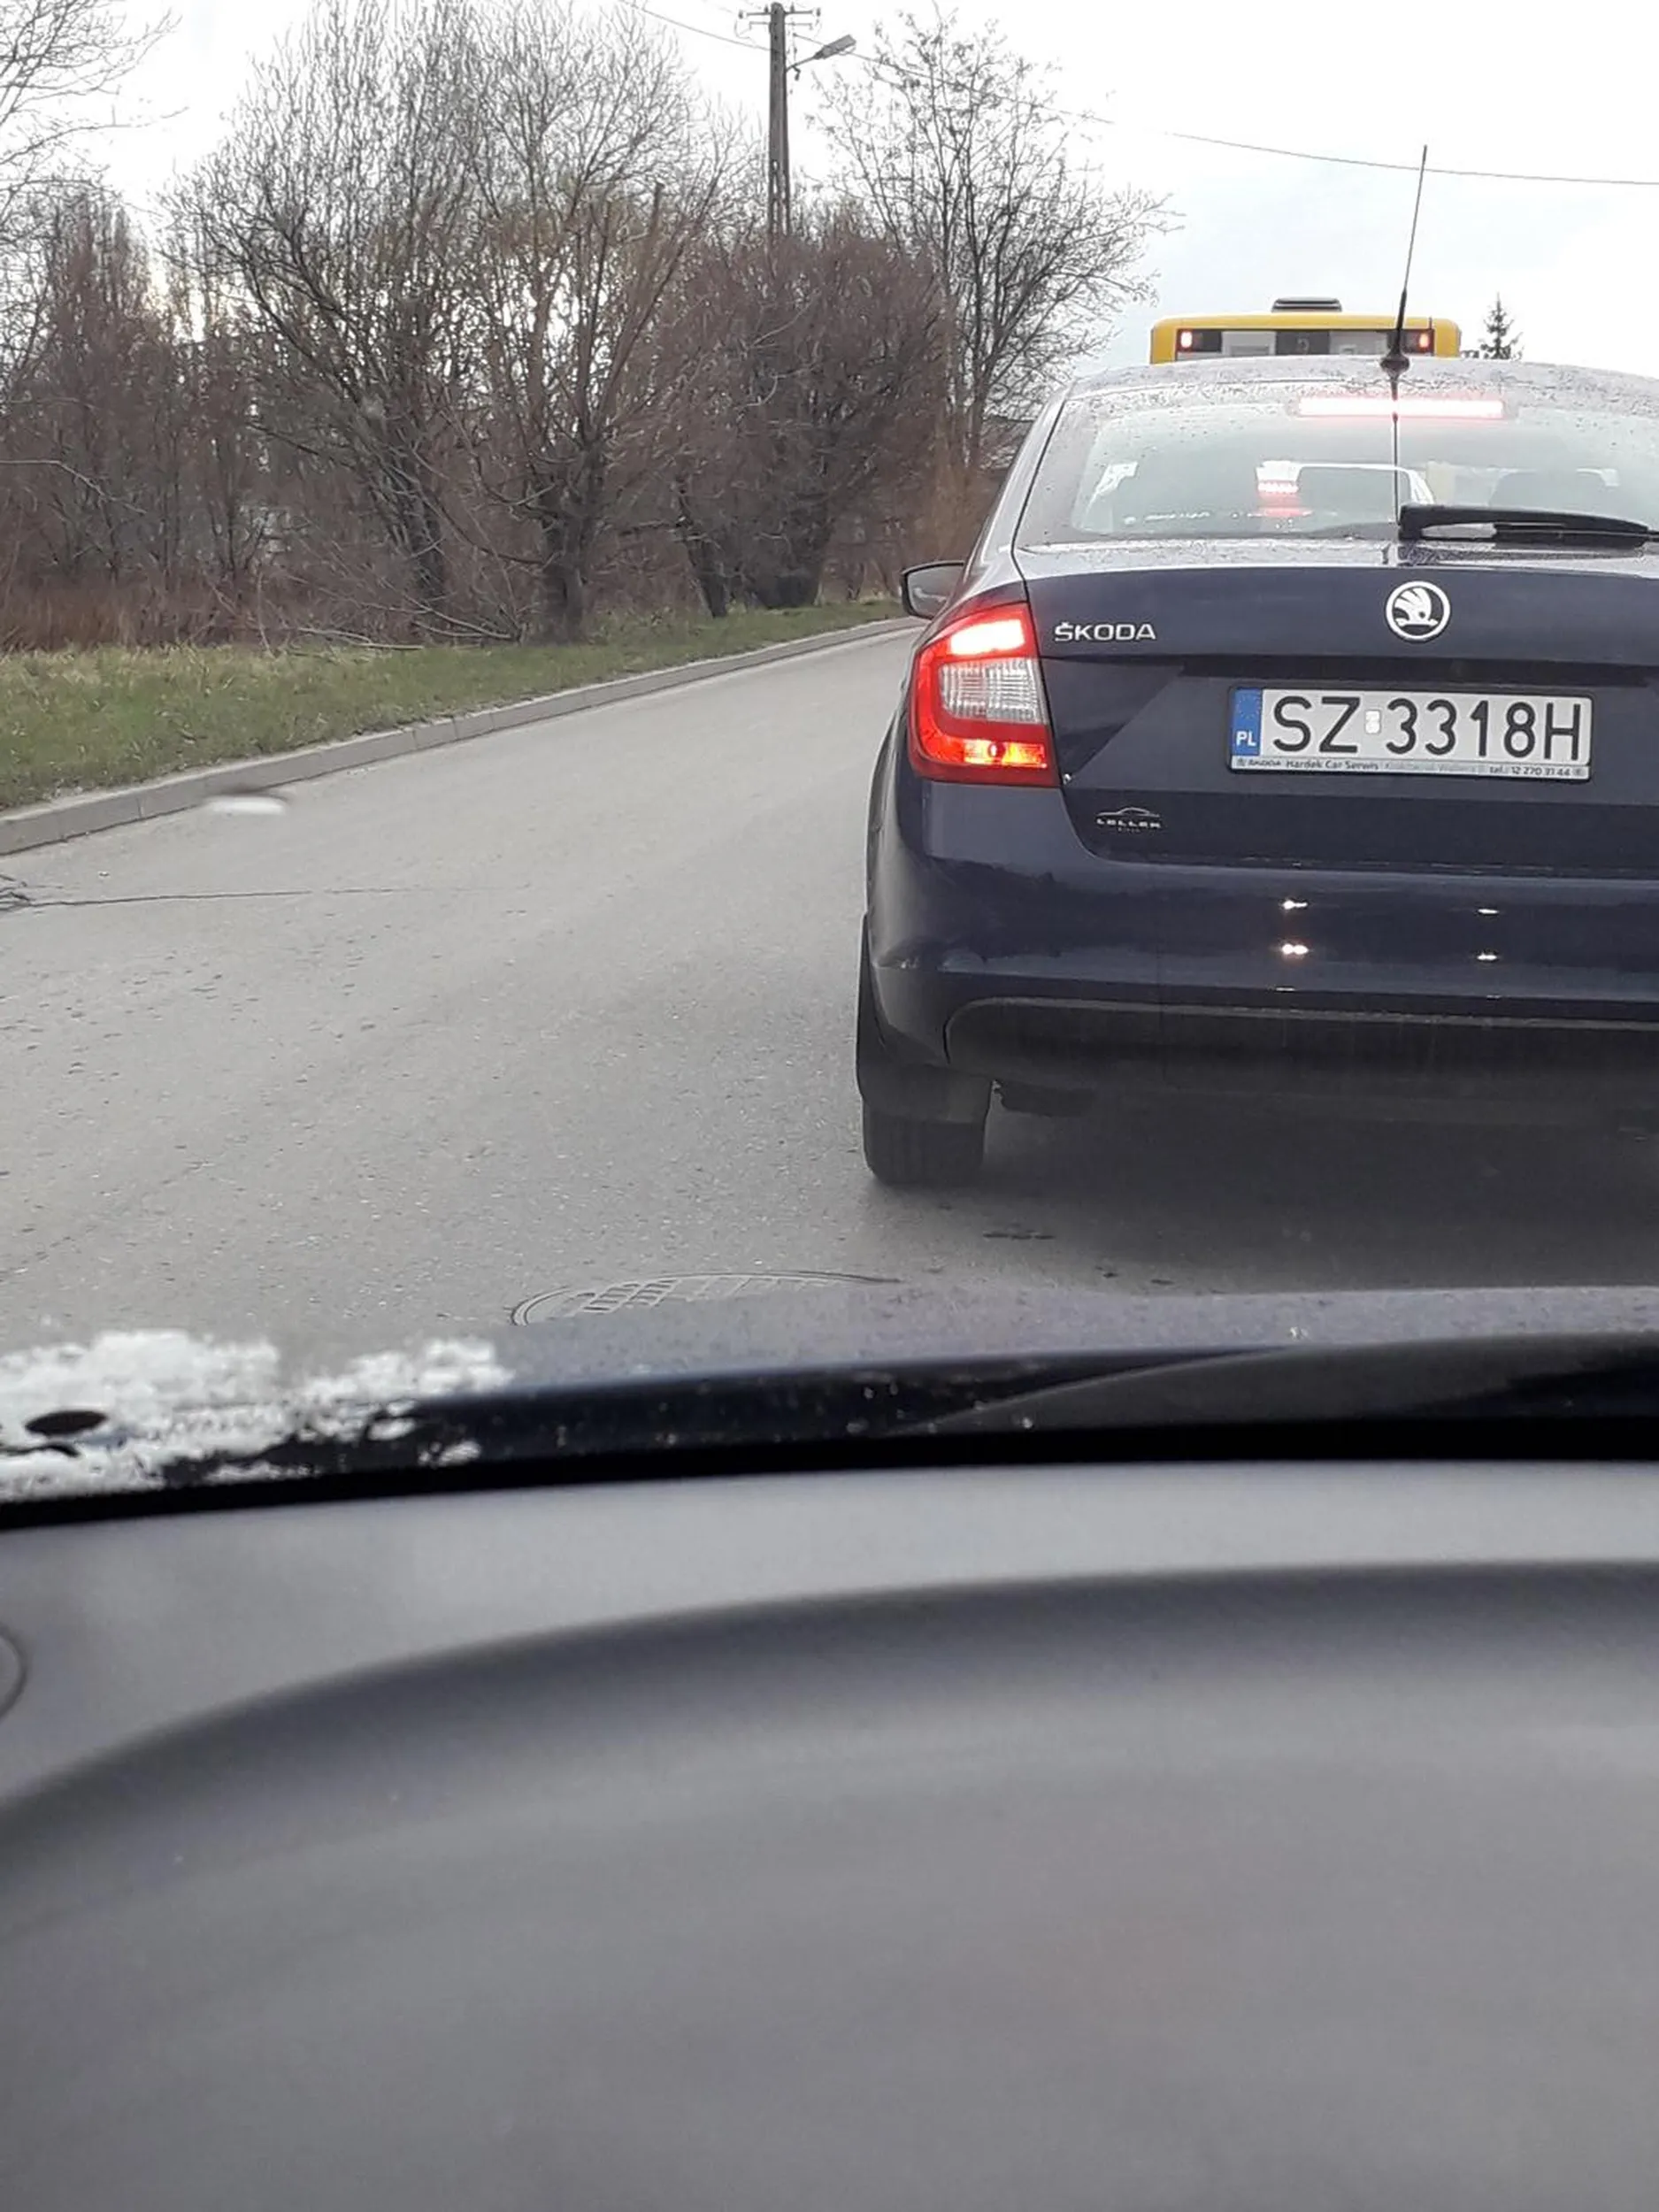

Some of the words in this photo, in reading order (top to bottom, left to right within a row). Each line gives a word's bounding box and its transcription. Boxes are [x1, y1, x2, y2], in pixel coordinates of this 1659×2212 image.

[1054, 621, 1156, 641] ŠKODA
[1272, 695, 1361, 753] SZ
[1386, 698, 1582, 761] 3318H
[1235, 731, 1256, 747] PL
[1325, 760, 1341, 769] Car
[1523, 767, 1543, 776] 270
